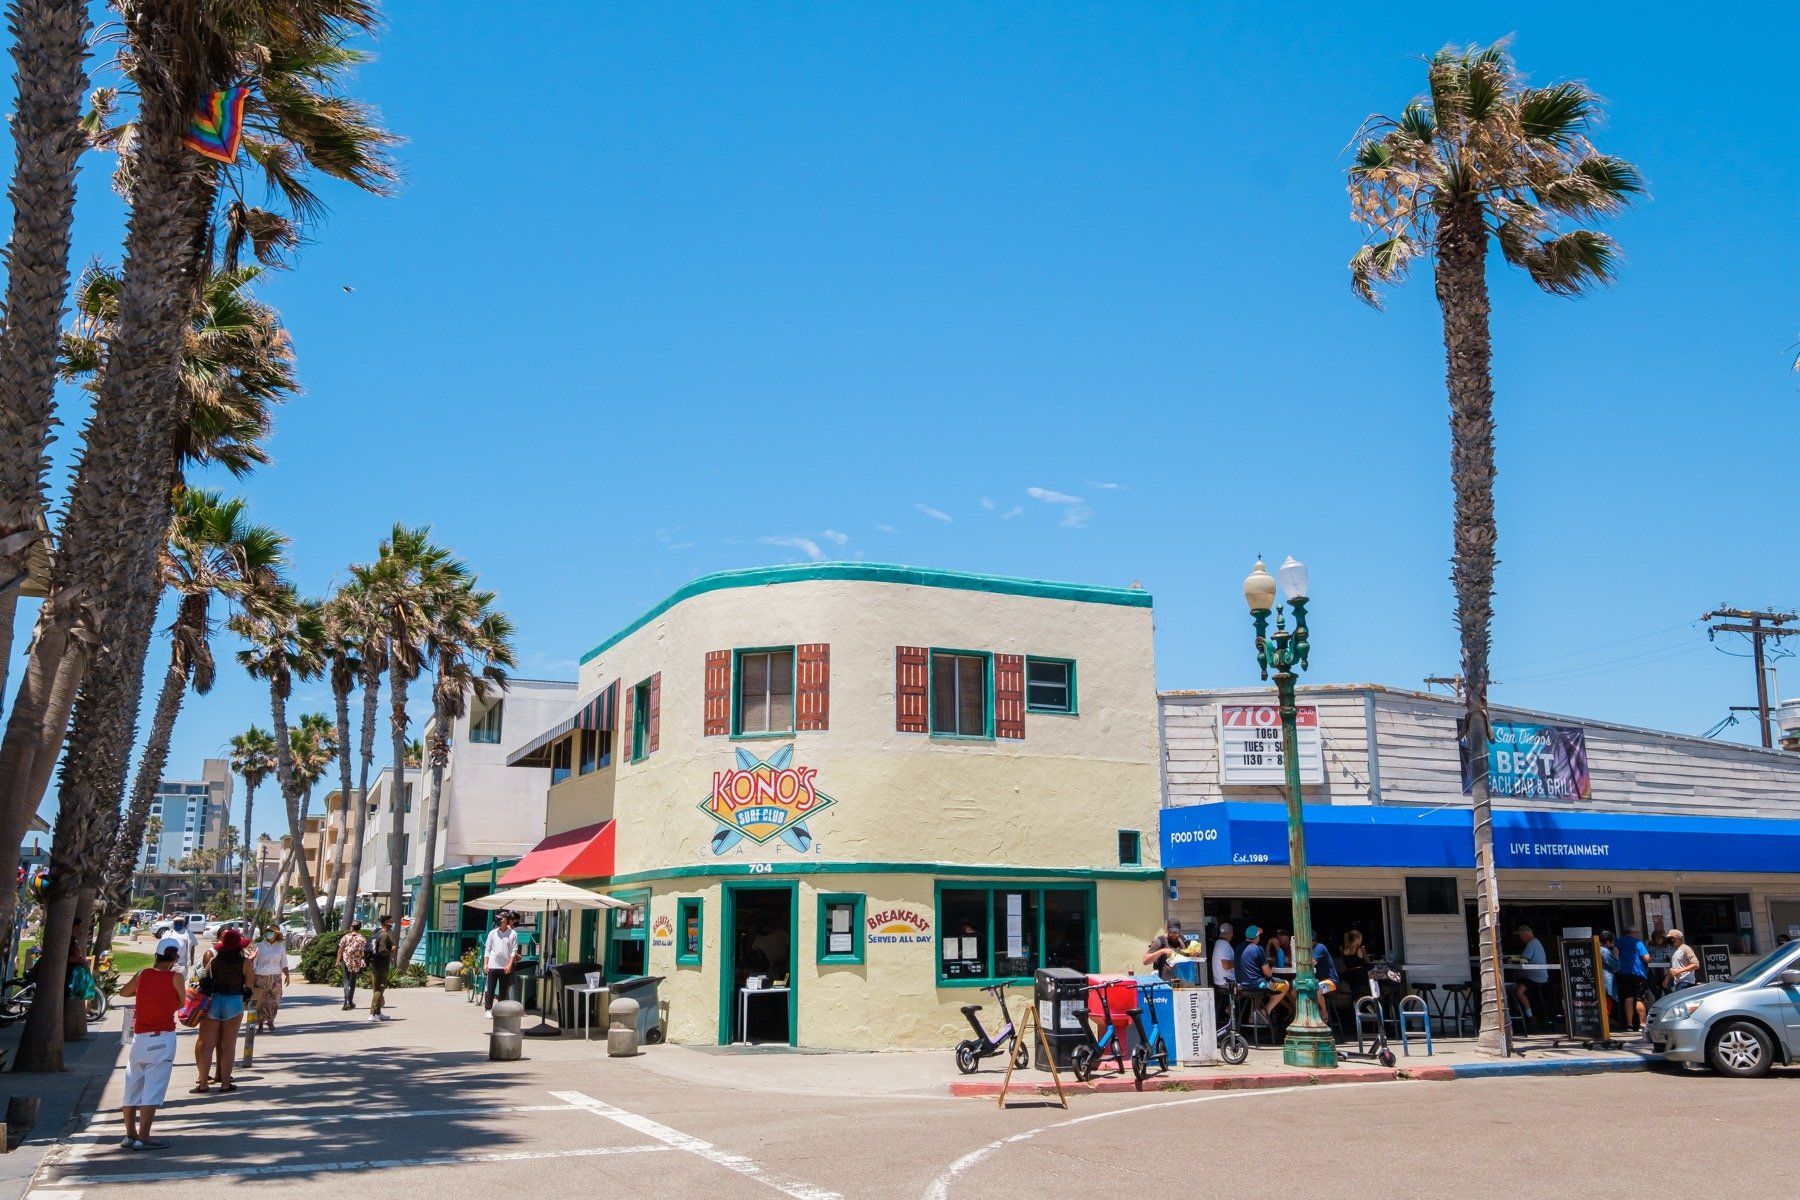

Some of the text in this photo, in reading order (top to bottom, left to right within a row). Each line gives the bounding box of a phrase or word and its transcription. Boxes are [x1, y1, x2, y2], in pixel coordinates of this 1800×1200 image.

[1223, 706, 1276, 726] 710
[1256, 728, 1278, 739] TOGO
[1496, 728, 1552, 746] San Diego's
[1244, 741, 1284, 752] TUES SU
[1243, 755, 1263, 766] 1130
[1496, 751, 1555, 776] BEST
[712, 767, 817, 812] KONO'S
[1514, 777, 1535, 794] BAR
[1537, 778, 1545, 795] &
[1547, 778, 1578, 797] GRILL
[738, 808, 785, 825] SURF CLUB
[1171, 829, 1218, 843] FOOD TO GO
[1510, 843, 1609, 856] LIVE ENTERTAINMENT
[749, 863, 773, 873] 704
[1596, 885, 1611, 895] 710
[867, 909, 930, 931] BREAKFAST
[899, 935, 913, 943] ALL
[916, 935, 932, 943] DAY
[1706, 953, 1727, 962] VOTED
[1190, 993, 1200, 1057] Union-Tribune
